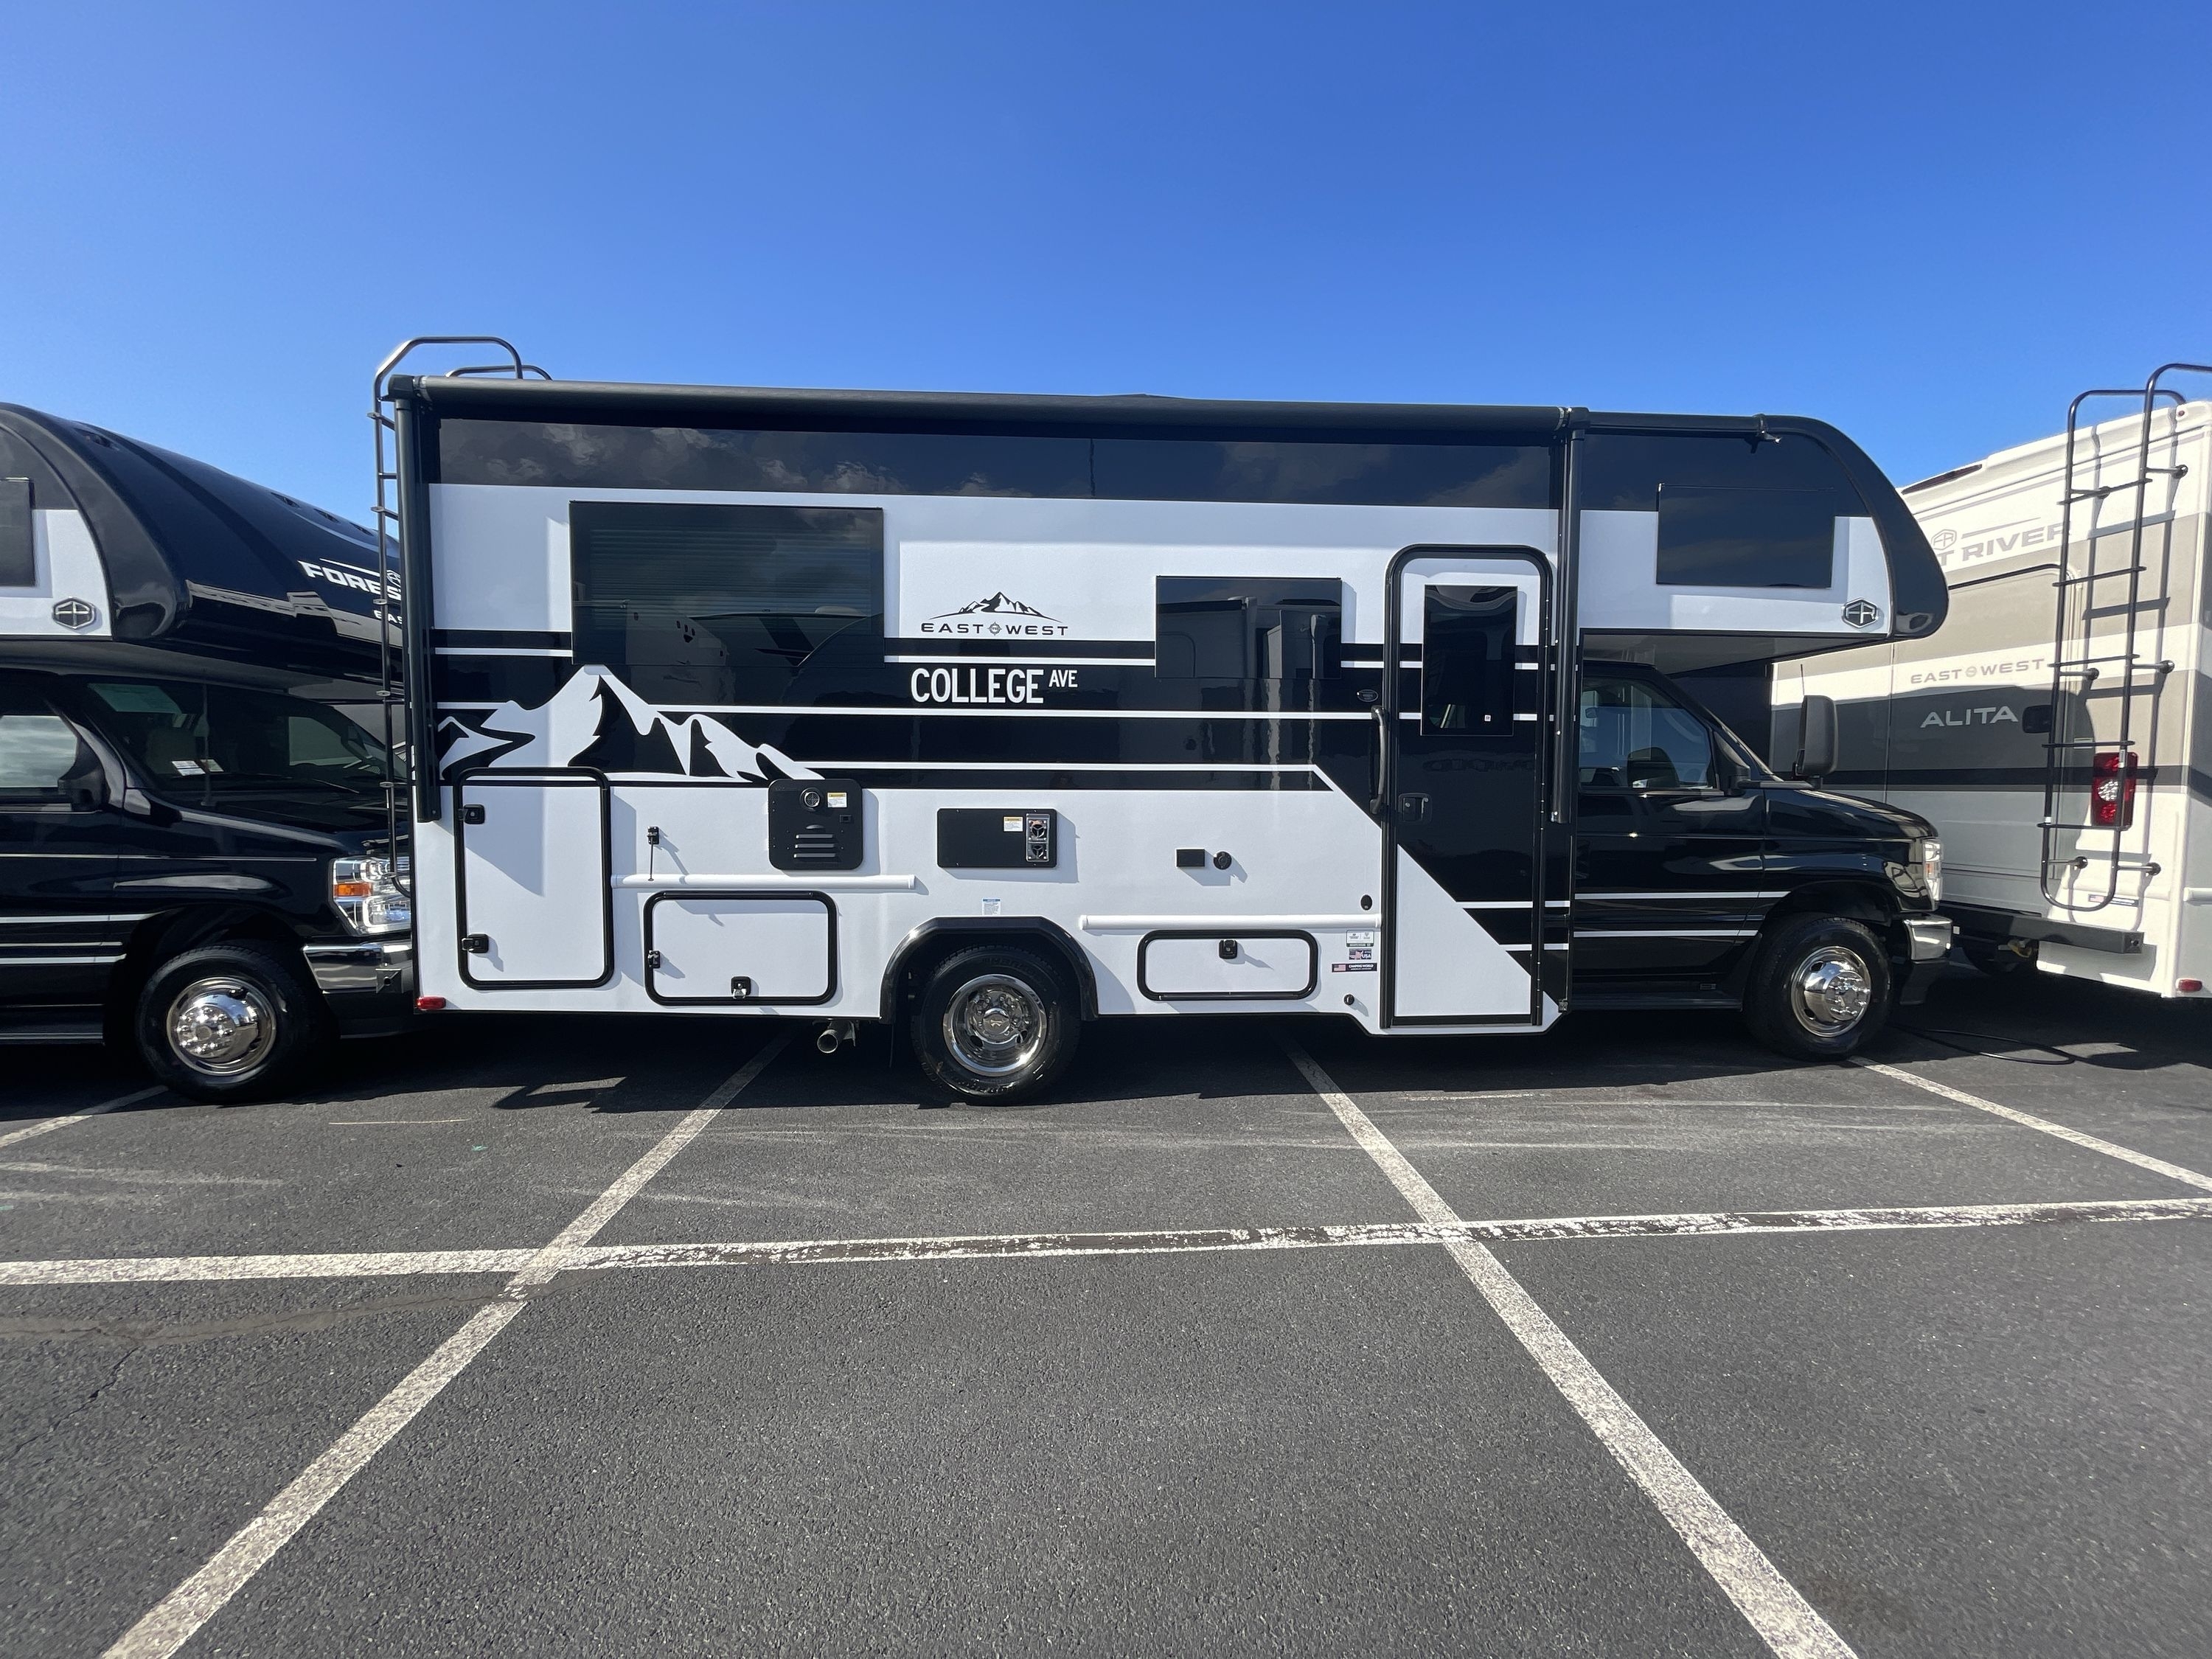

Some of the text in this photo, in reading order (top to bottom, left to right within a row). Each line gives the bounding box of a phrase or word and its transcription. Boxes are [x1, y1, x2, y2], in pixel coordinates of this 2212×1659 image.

[297, 560, 401, 601] FORES
[921, 622, 984, 634] EAST
[1006, 624, 1068, 636] WEST
[1910, 658, 2045, 684] EAST WEST
[911, 667, 1078, 704] COLLEGE AVE
[1920, 705, 2019, 728] ALITA
